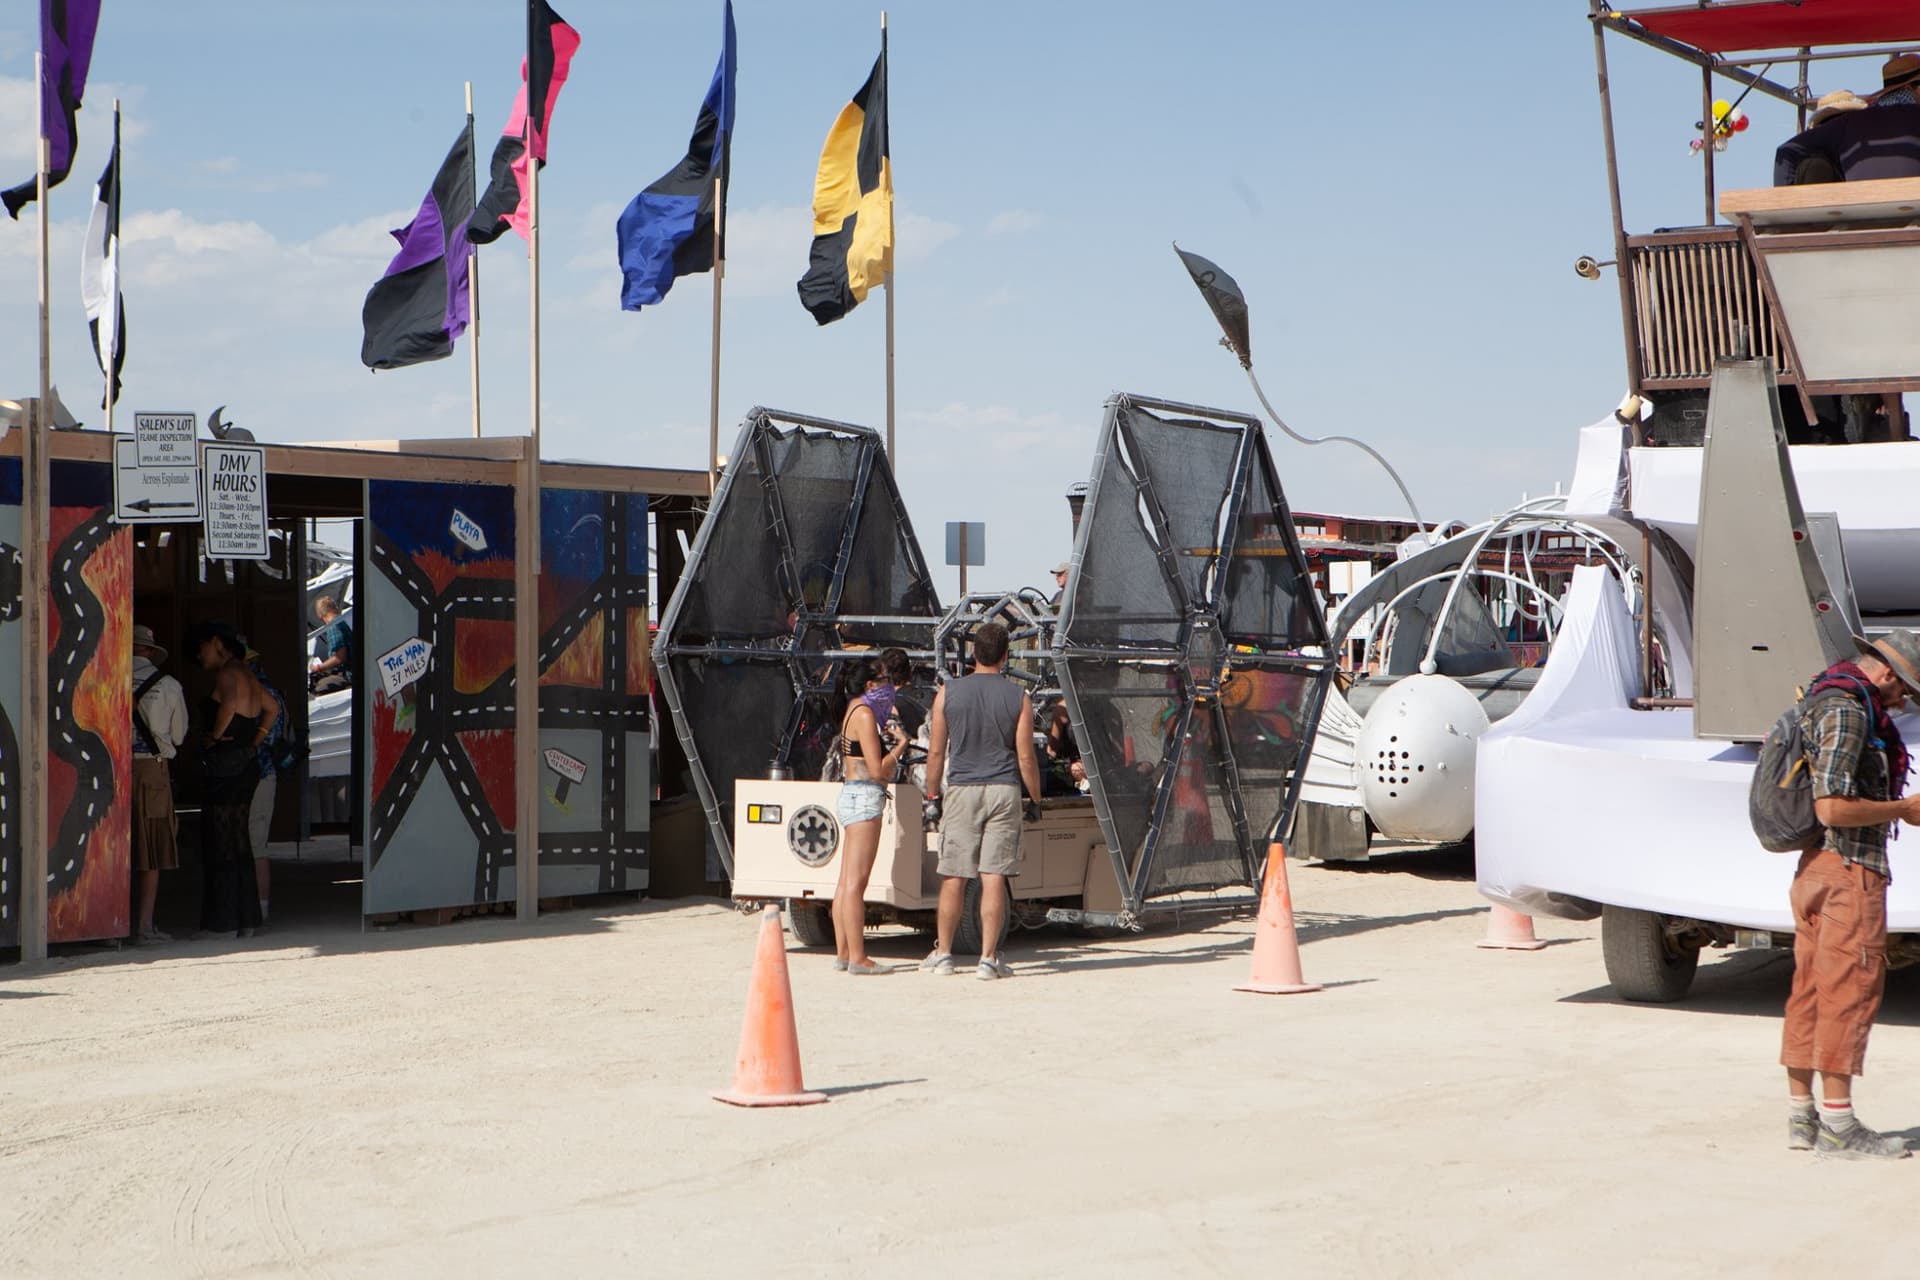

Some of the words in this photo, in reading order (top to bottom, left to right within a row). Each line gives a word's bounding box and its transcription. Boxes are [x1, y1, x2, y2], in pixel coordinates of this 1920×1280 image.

[139, 419, 175, 431] SALEM'S
[177, 419, 192, 431] LOT
[139, 433, 158, 442] FLAME
[159, 433, 193, 442] INSPECTION
[159, 444, 174, 452] AREA
[219, 453, 251, 472] DMV
[141, 473, 160, 485] Across
[161, 473, 190, 487] Esplanade
[212, 473, 258, 493] HOURS
[453, 512, 480, 542] PLAYA
[212, 531, 233, 540] Second
[384, 655, 404, 671] THE
[405, 641, 425, 661] MAN
[391, 671, 401, 687] 37
[404, 656, 426, 678] MILES
